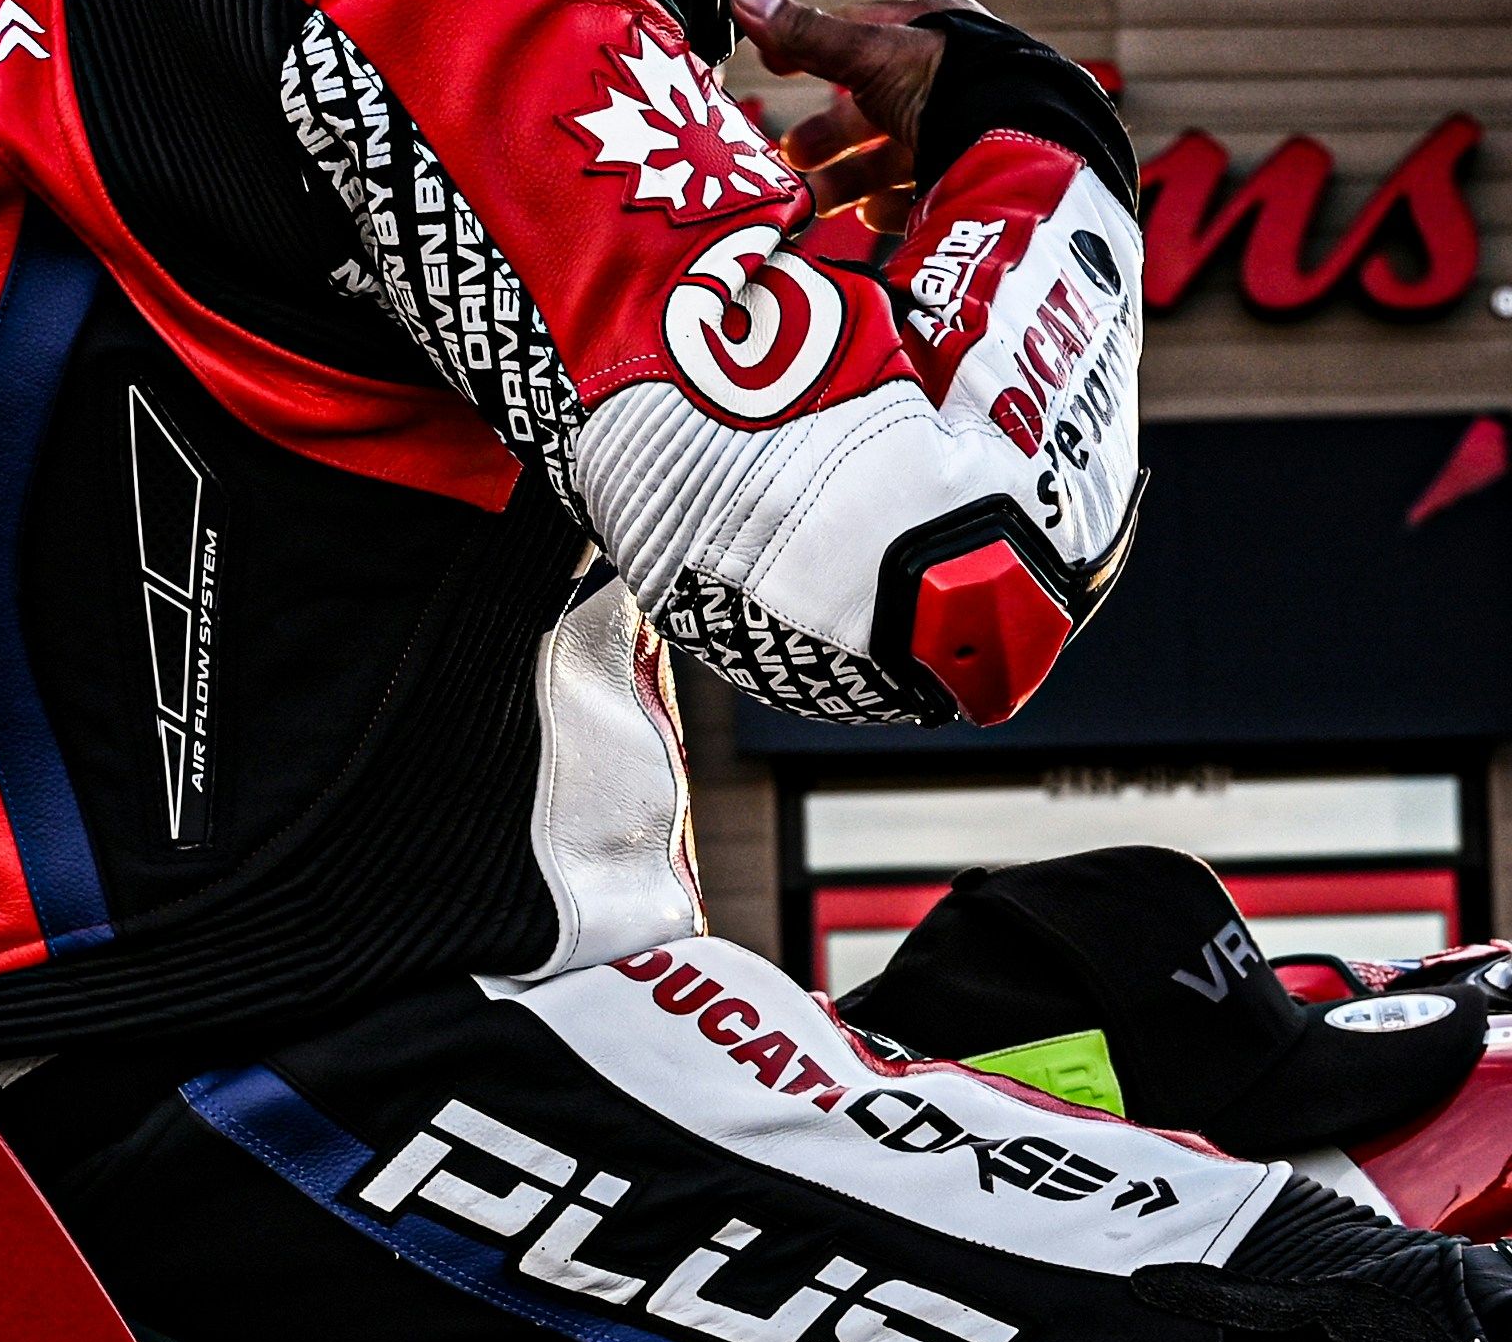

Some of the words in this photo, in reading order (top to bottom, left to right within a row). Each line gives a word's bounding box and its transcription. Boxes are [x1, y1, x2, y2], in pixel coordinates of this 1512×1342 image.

[365, 178, 400, 246] BY
[199, 529, 218, 644] SYSTEM
[194, 646, 210, 739] FLOW
[191, 745, 206, 793] AIR
[1172, 919, 1260, 1004] VR
[613, 947, 850, 1114] DUCATI
